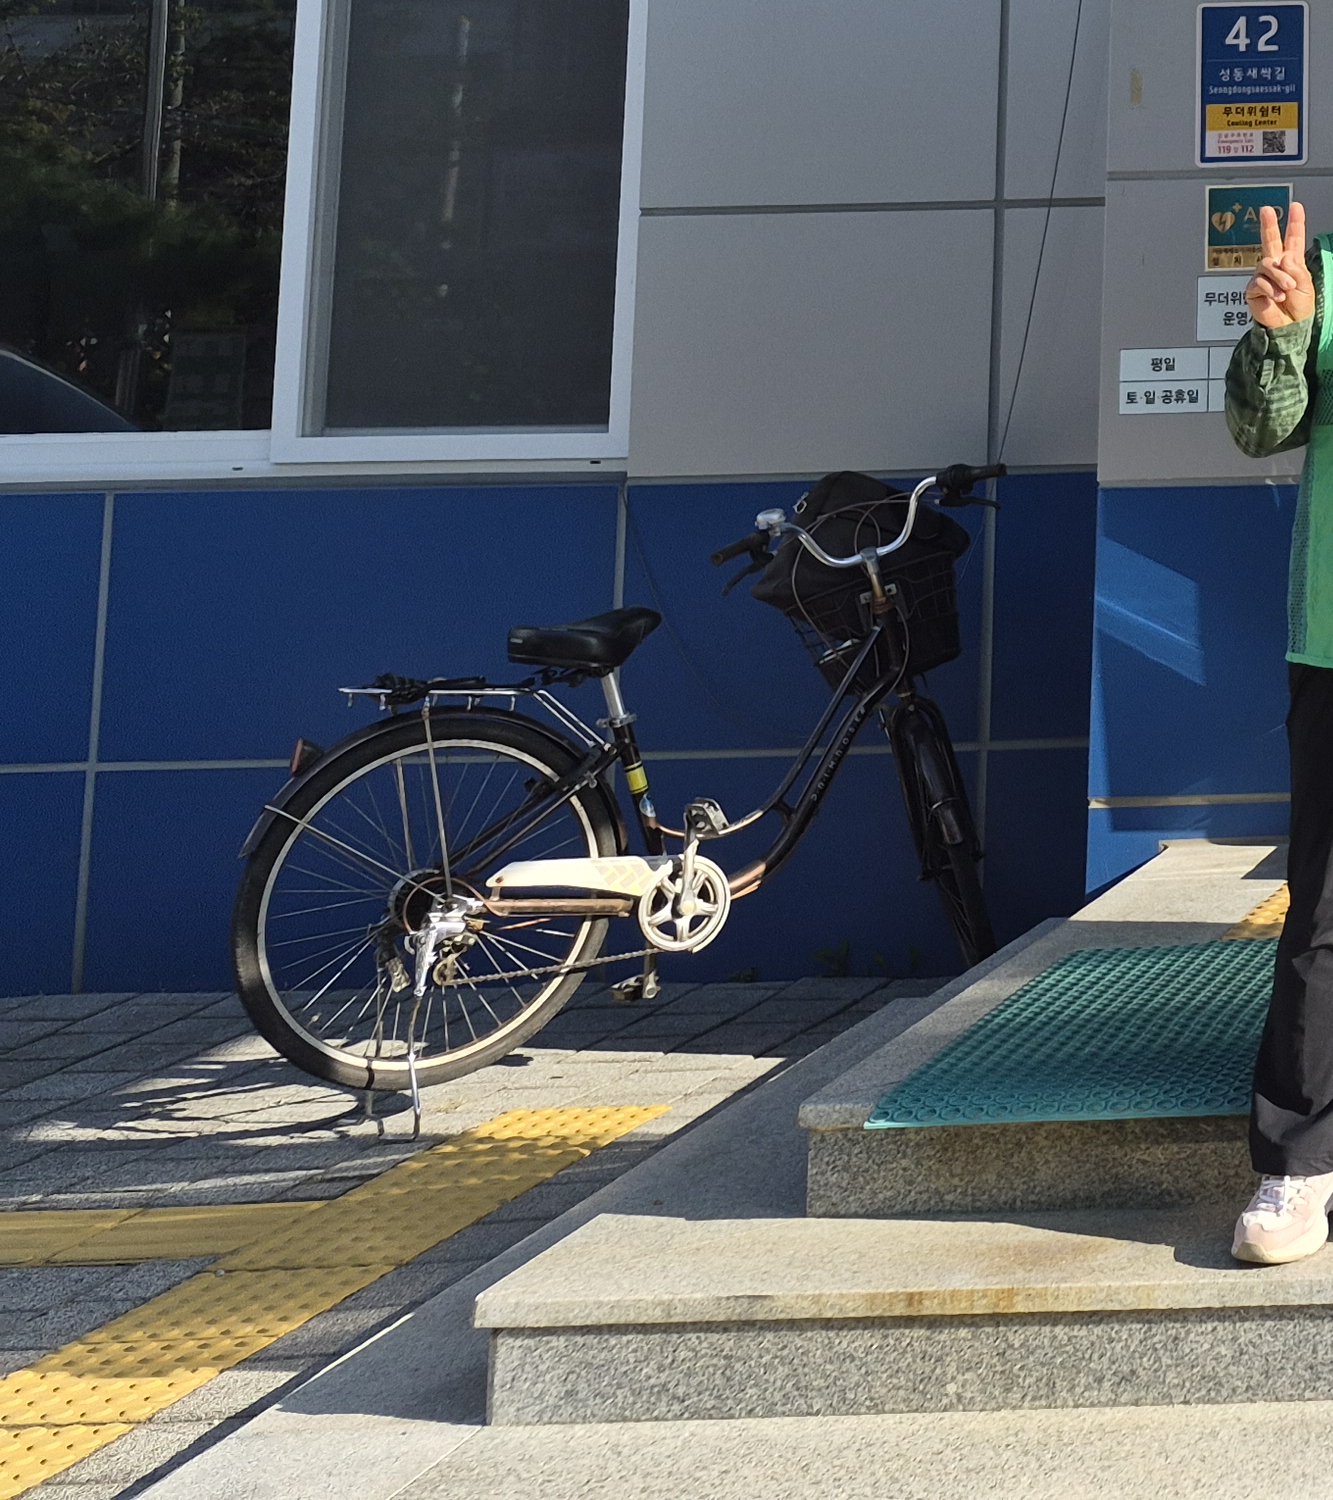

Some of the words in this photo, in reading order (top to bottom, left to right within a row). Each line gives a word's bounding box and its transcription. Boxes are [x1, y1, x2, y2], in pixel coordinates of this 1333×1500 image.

[1225, 15, 1279, 52] 42
[1219, 66, 1286, 82] 성동새싹길
[1222, 105, 1282, 118] 무더위쉼터
[1254, 118, 1278, 127] Center
[1217, 145, 1232, 154] 119
[1240, 144, 1255, 154] 112
[1204, 291, 1249, 307] 무더위
[1222, 310, 1253, 327] 운영
[1150, 357, 1176, 372] 평일
